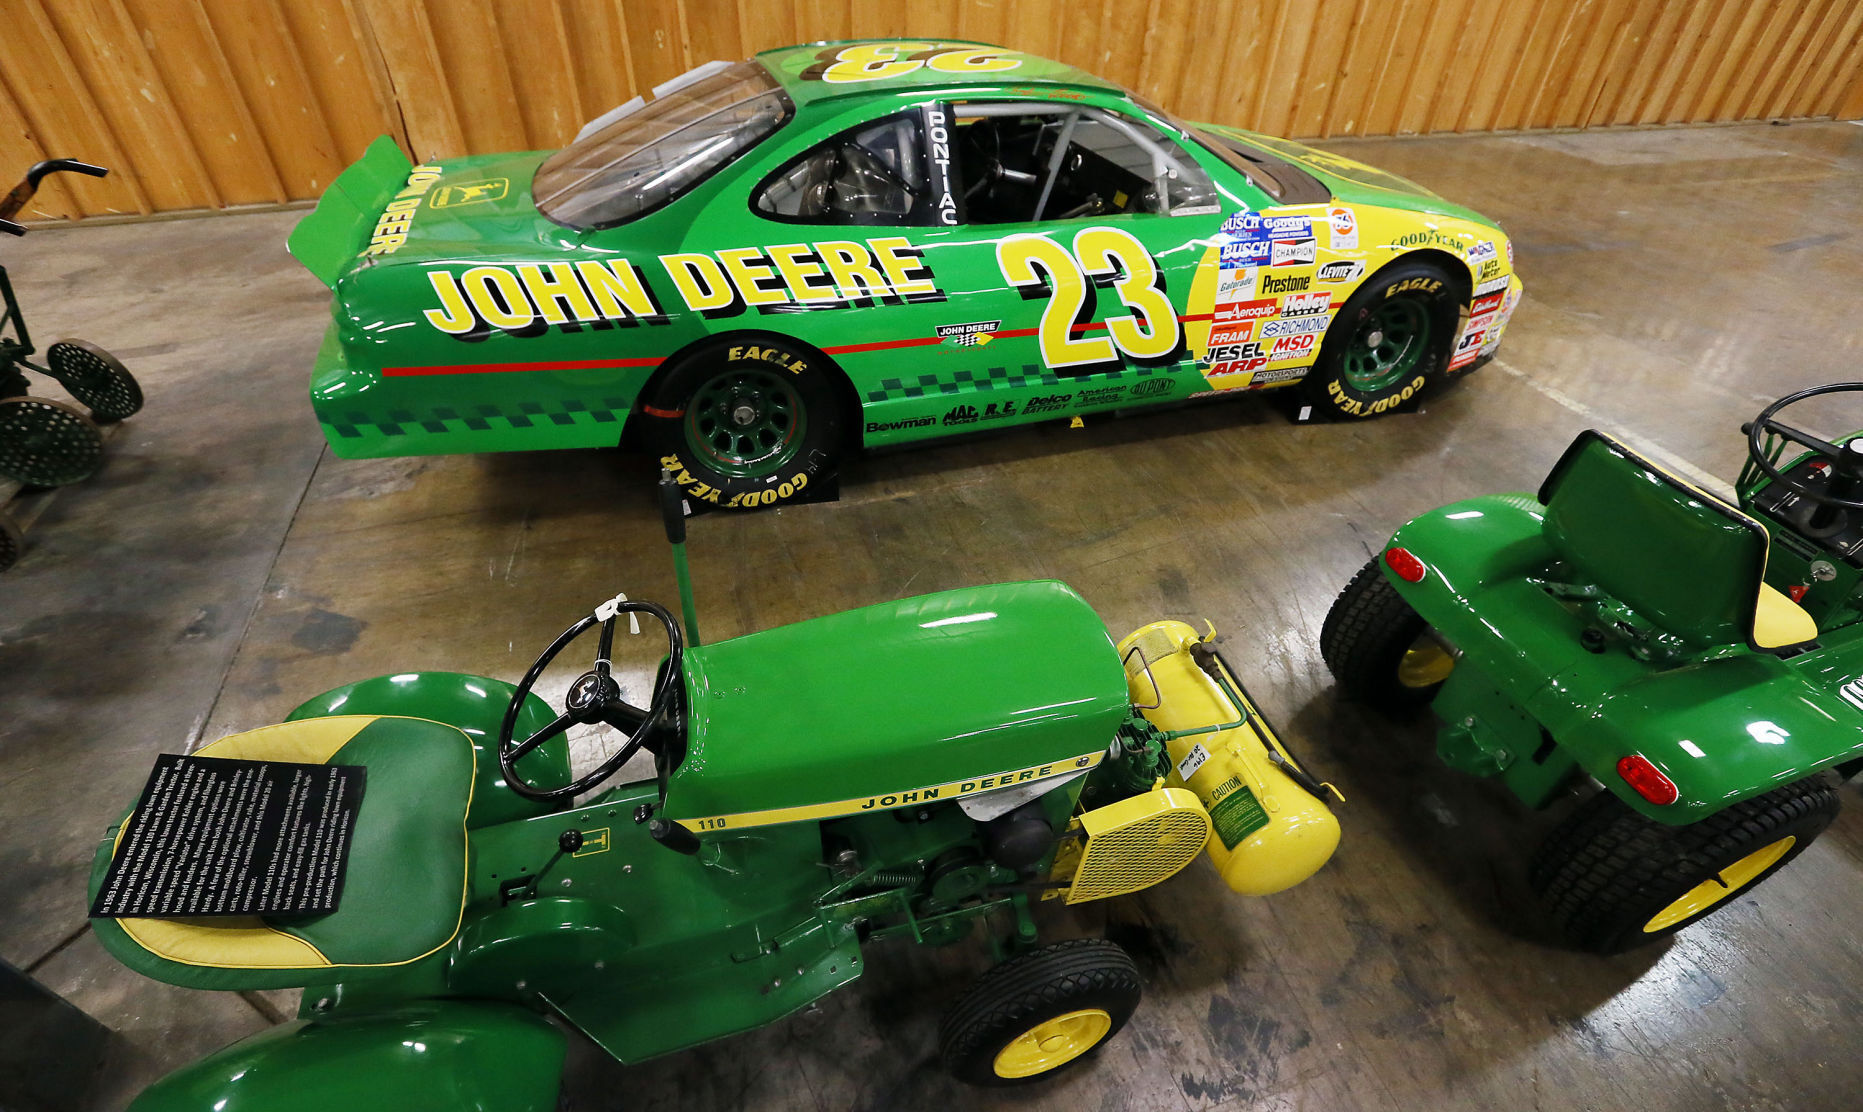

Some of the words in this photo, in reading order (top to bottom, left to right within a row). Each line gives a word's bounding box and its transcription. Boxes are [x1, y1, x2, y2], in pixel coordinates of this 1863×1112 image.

[928, 111, 958, 225] PONTIAC
[1221, 241, 1270, 260] BUSCH
[1275, 247, 1313, 258] CHAMPION
[422, 257, 659, 335] JOHN
[657, 236, 937, 312] DEERE
[1220, 277, 1253, 291] Gatorade
[1262, 275, 1311, 294] Prestone
[1385, 277, 1443, 299] EAGLE
[996, 226, 1181, 369] 23
[1283, 294, 1331, 313] Holley
[1230, 303, 1276, 319] Aeroquip
[940, 325, 965, 336] JOHN
[966, 323, 996, 333] DEERE
[1280, 316, 1329, 335] RICHMOND
[1211, 330, 1250, 345] FRAM
[1273, 334, 1315, 352] MSD
[727, 346, 808, 375] EAGLE
[1203, 342, 1265, 363] JESEL
[1270, 350, 1310, 361] IGNITION
[1206, 357, 1268, 377] ARP
[1027, 394, 1073, 406] Delco
[1327, 375, 1425, 418] GOODYEAR
[1021, 404, 1067, 415] BATTERY
[866, 416, 936, 433] Bowman
[861, 788, 940, 811] JOHN
[960, 764, 1053, 794] DEERE
[1212, 776, 1242, 801] CAUTION
[698, 817, 727, 831] 110
[109, 875, 123, 890] John
[158, 888, 175, 913] variable
[168, 870, 183, 888] speed
[172, 897, 186, 913] hood
[183, 860, 198, 884] fenders.
[103, 890, 117, 905] 1963
[114, 888, 134, 913] industry
[125, 873, 138, 887] with
[132, 880, 151, 906] Horicon,
[186, 886, 203, 913] available
[200, 892, 215, 912] Hardy.
[144, 895, 160, 913] speed
